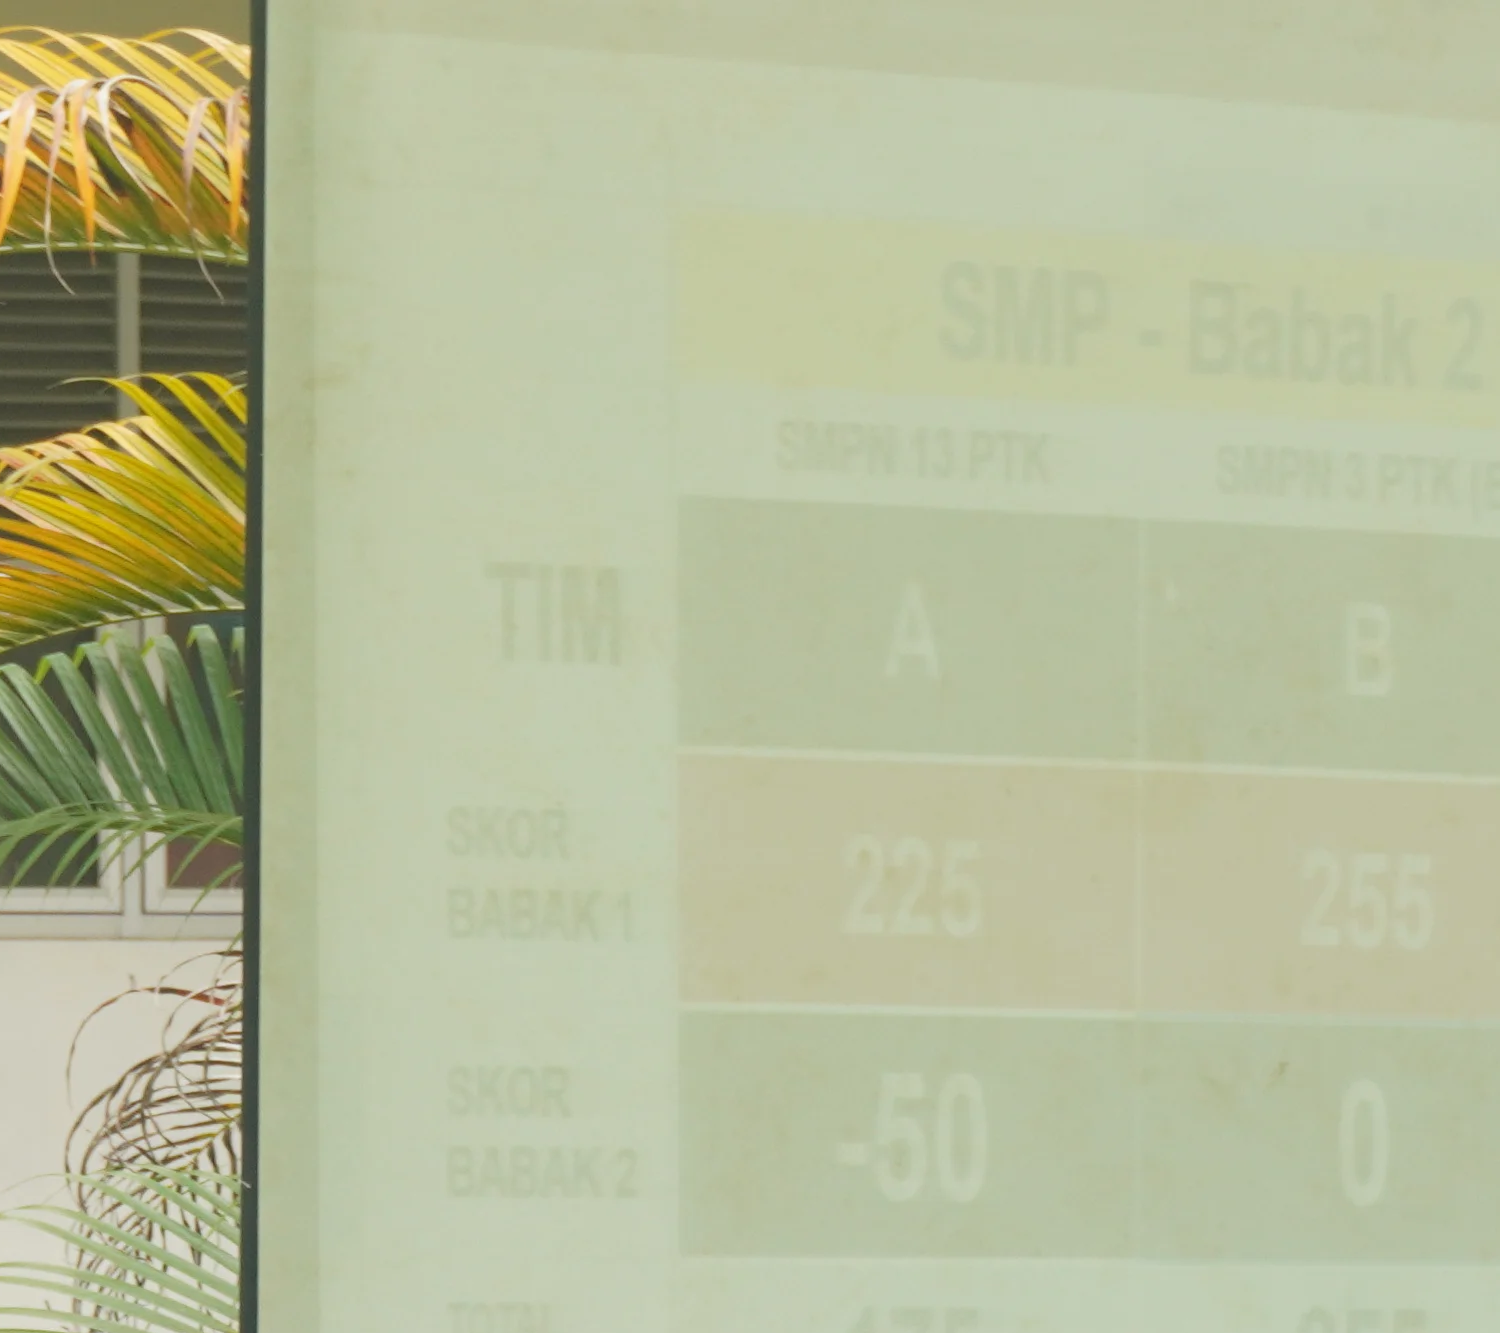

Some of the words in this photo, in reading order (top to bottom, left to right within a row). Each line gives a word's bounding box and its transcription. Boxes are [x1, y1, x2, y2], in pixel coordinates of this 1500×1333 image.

[939, 260, 1111, 369] SMP
[1190, 279, 1416, 391] Babak
[1443, 297, 1486, 392] 2
[777, 418, 900, 475] SMPN
[912, 426, 956, 477] 13
[970, 430, 1050, 486] PTK
[1216, 441, 1336, 502] SMPN
[1345, 452, 1368, 503] 3
[1377, 454, 1459, 510] PTK
[485, 560, 625, 668] TIM
[884, 586, 943, 681] A
[1346, 604, 1393, 698] B
[447, 805, 569, 862] SKOR
[447, 887, 597, 941] BABAK
[842, 833, 982, 939] 225
[1300, 850, 1434, 949] 255
[447, 1065, 572, 1119] SKOR
[837, 1072, 988, 1201] -50
[447, 1145, 600, 1199] BABAK
[612, 1148, 639, 1199] 2
[1339, 1081, 1389, 1206] 0
